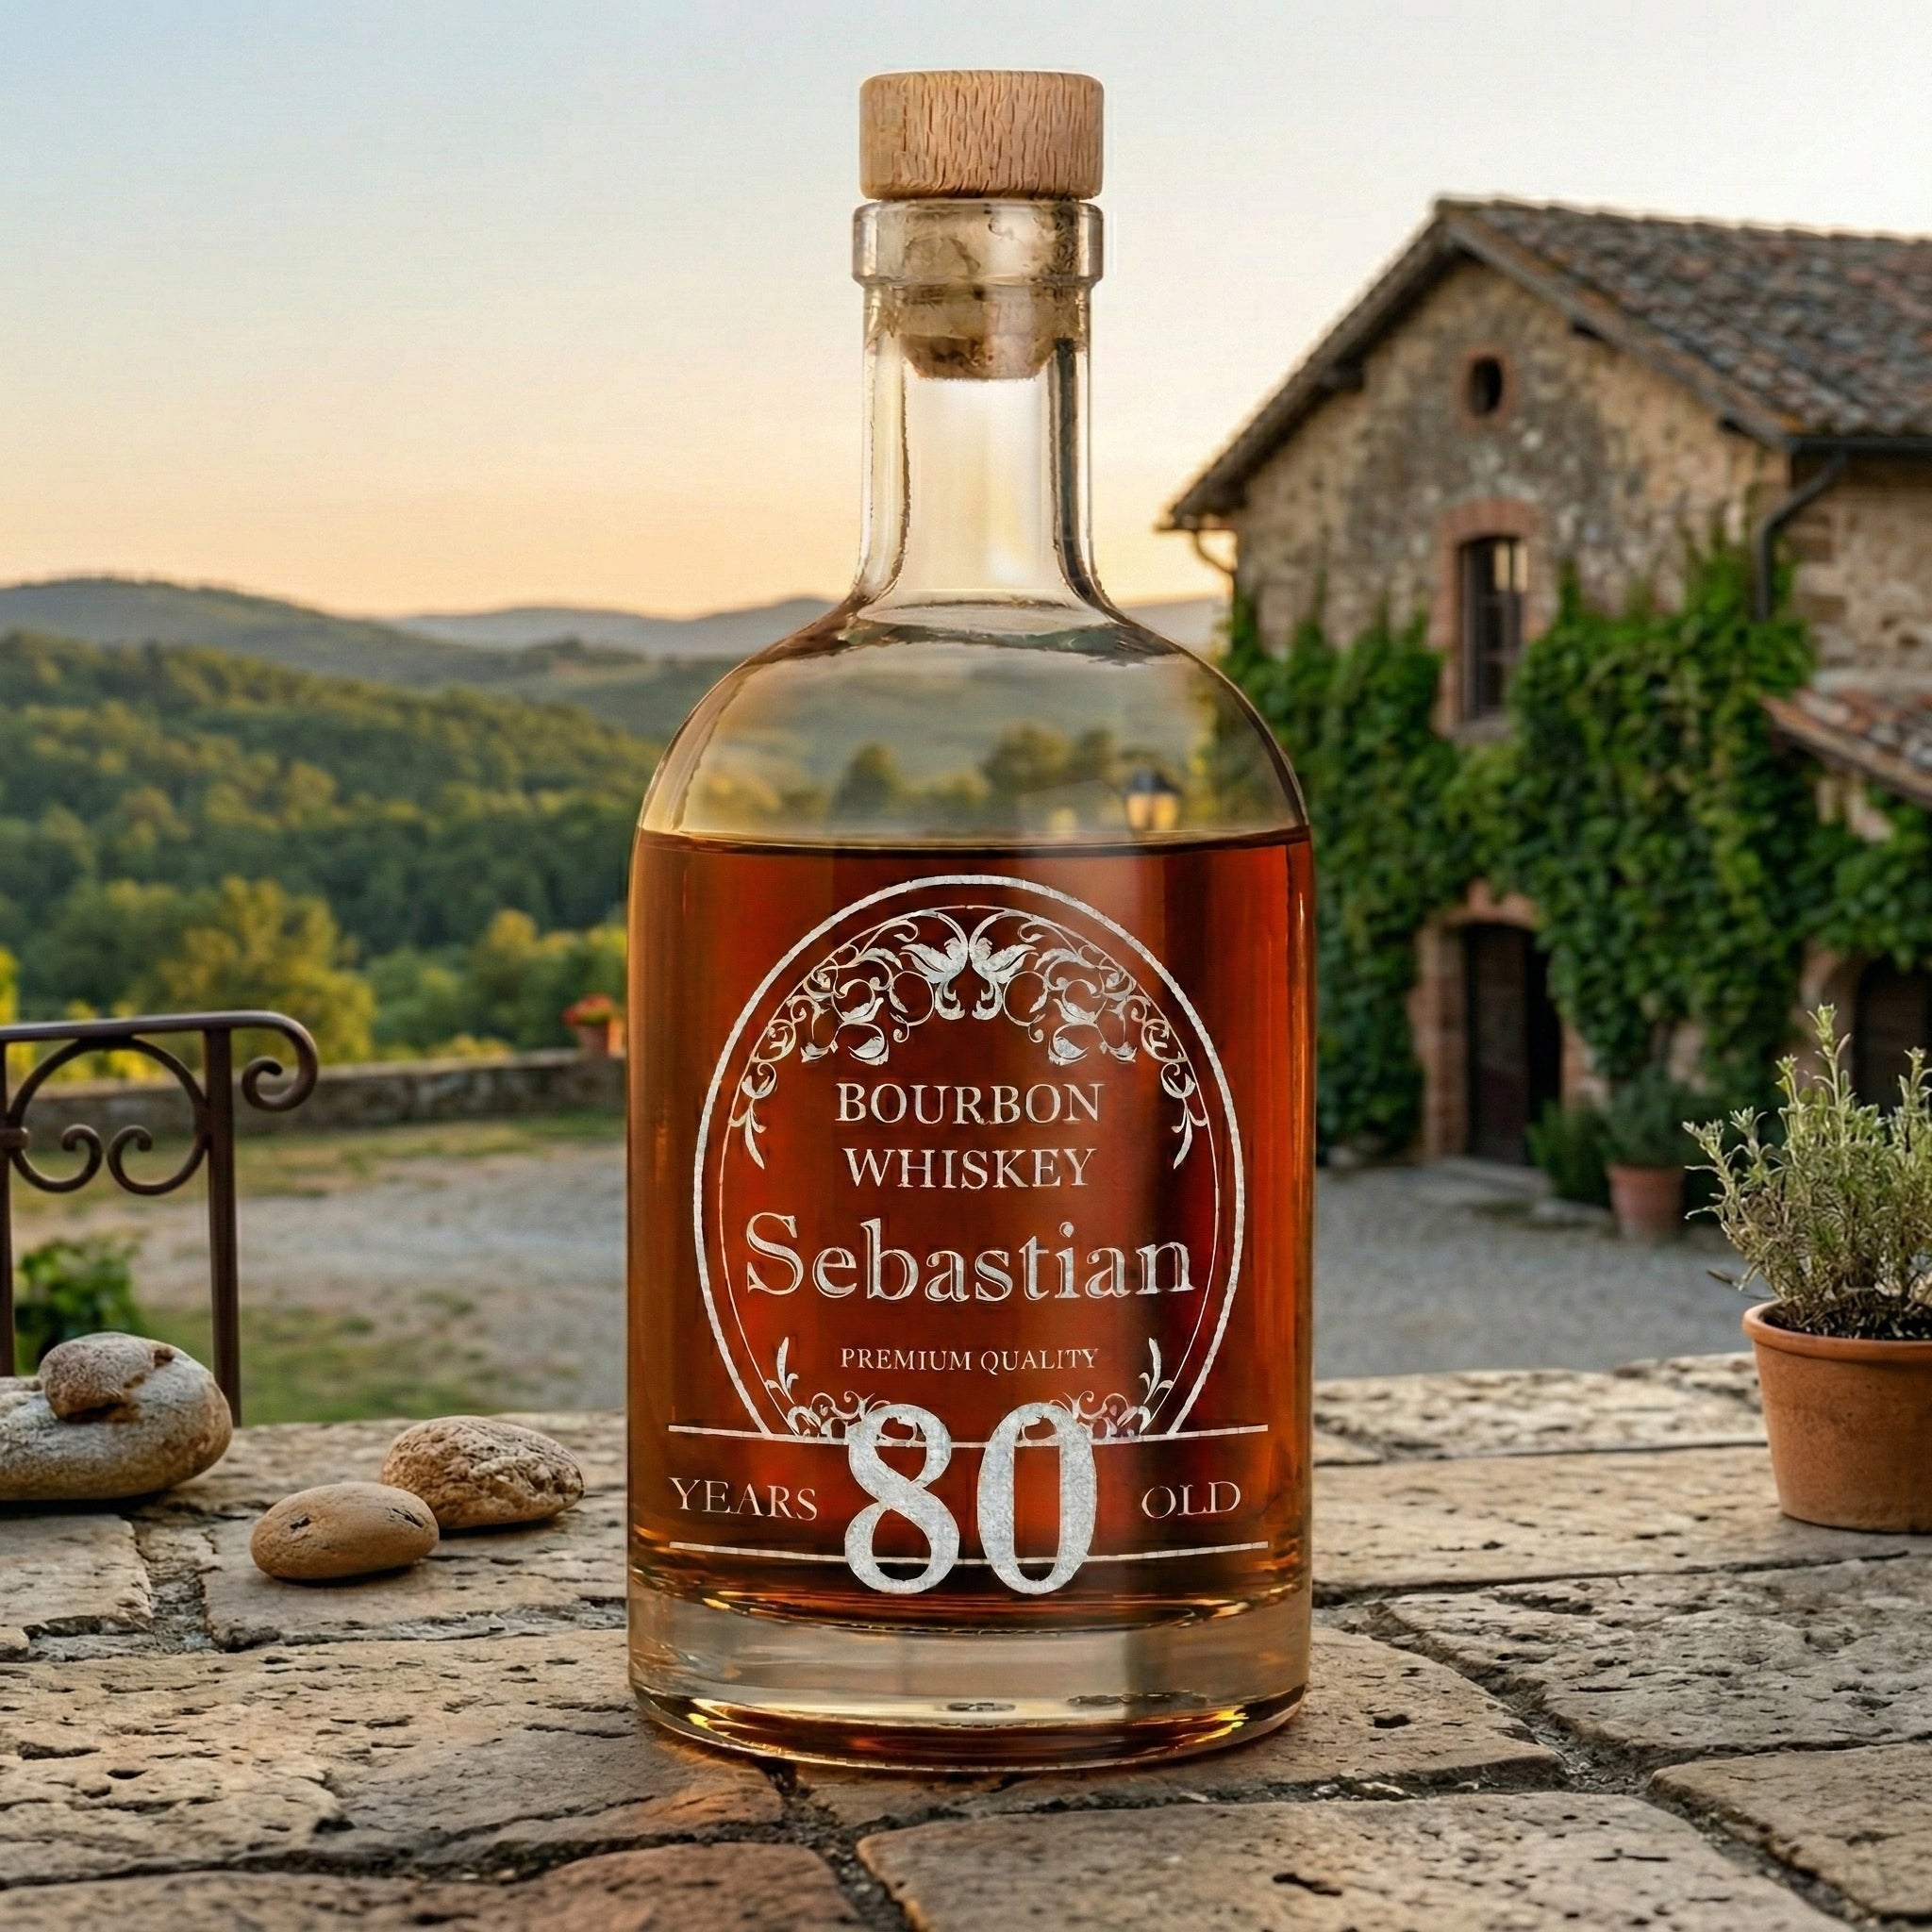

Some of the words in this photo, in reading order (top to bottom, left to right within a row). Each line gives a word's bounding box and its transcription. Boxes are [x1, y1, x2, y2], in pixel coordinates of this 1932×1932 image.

[836, 1083, 1104, 1124] BOURBON
[842, 1148, 1096, 1189] WHISKEY
[746, 1212, 1195, 1303] Sebastian
[841, 1348, 971, 1371] PREMIUM
[981, 1348, 1098, 1374] QUALITY
[669, 1477, 818, 1521] YEARS
[844, 1403, 1097, 1594] 80
[1141, 1481, 1241, 1519] OLD
